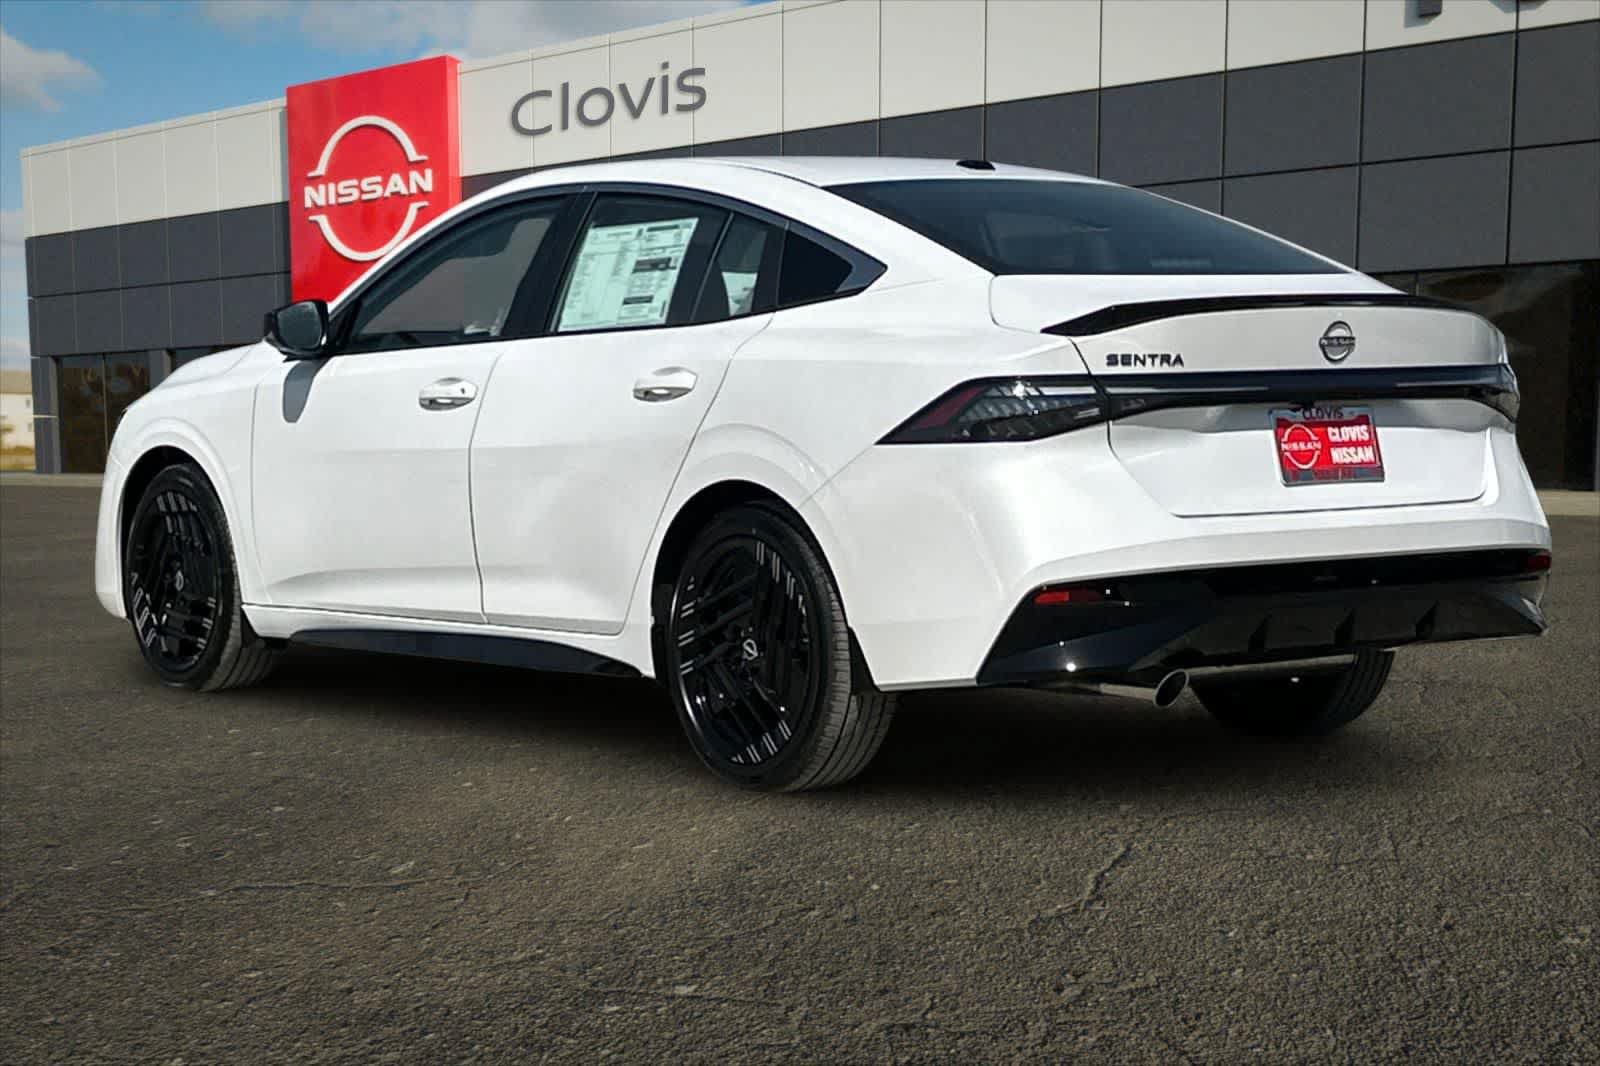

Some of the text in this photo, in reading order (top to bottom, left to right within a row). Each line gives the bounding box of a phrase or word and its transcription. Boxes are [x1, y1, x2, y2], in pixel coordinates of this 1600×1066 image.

[303, 167, 433, 208] NISSAN
[1105, 353, 1185, 368] SENTRA
[1302, 407, 1344, 420] CLOVIS
[1327, 425, 1370, 443] CLOVIS
[1281, 440, 1322, 452] NISSAN
[1330, 445, 1375, 465] NISSAN
